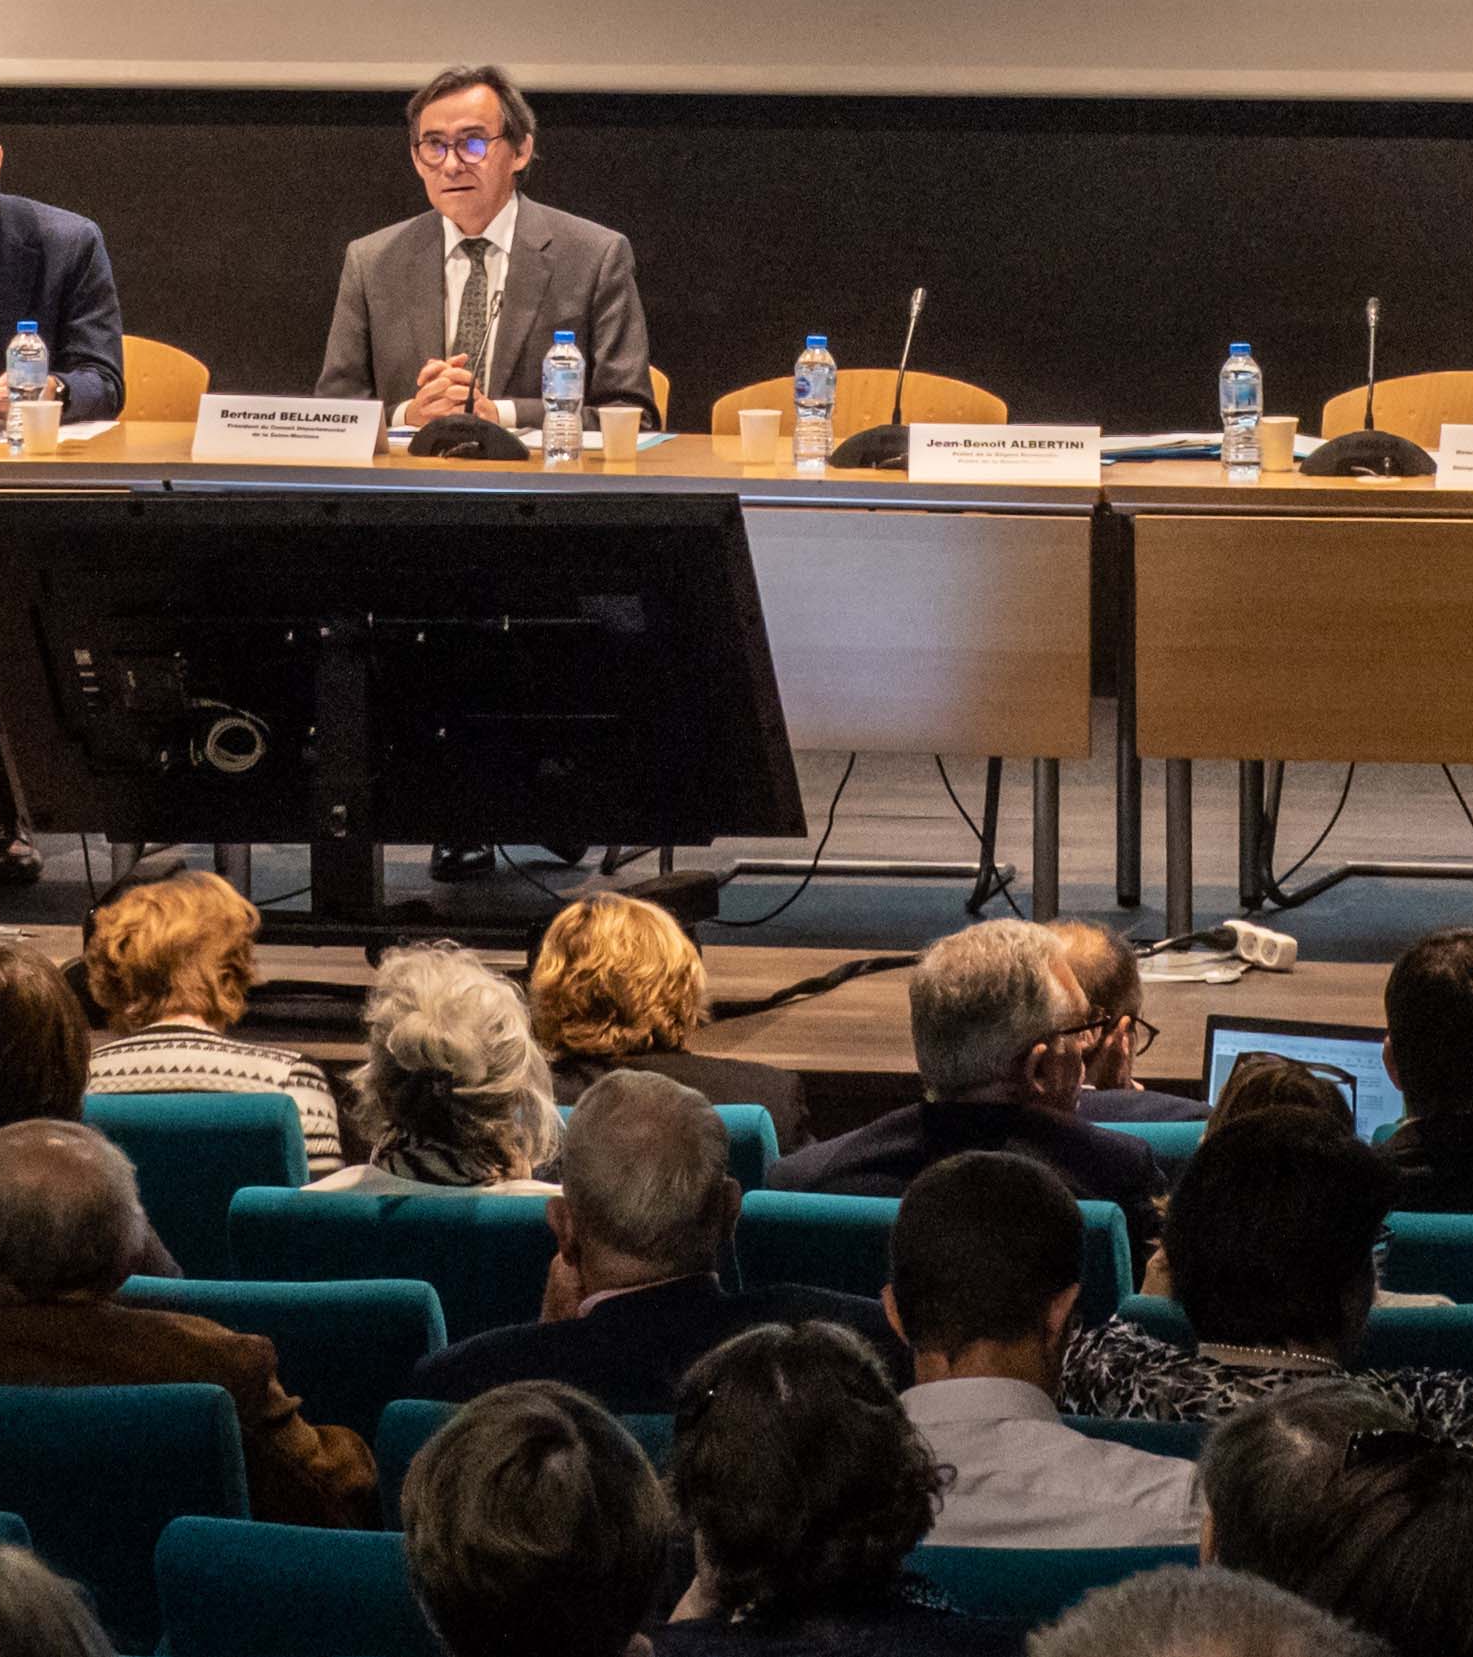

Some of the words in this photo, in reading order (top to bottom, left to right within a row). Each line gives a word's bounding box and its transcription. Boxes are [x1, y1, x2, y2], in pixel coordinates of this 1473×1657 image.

[220, 409, 276, 421] Bertrand
[280, 412, 359, 424] BELLANGER
[1010, 440, 1085, 449] ALBERTINI
